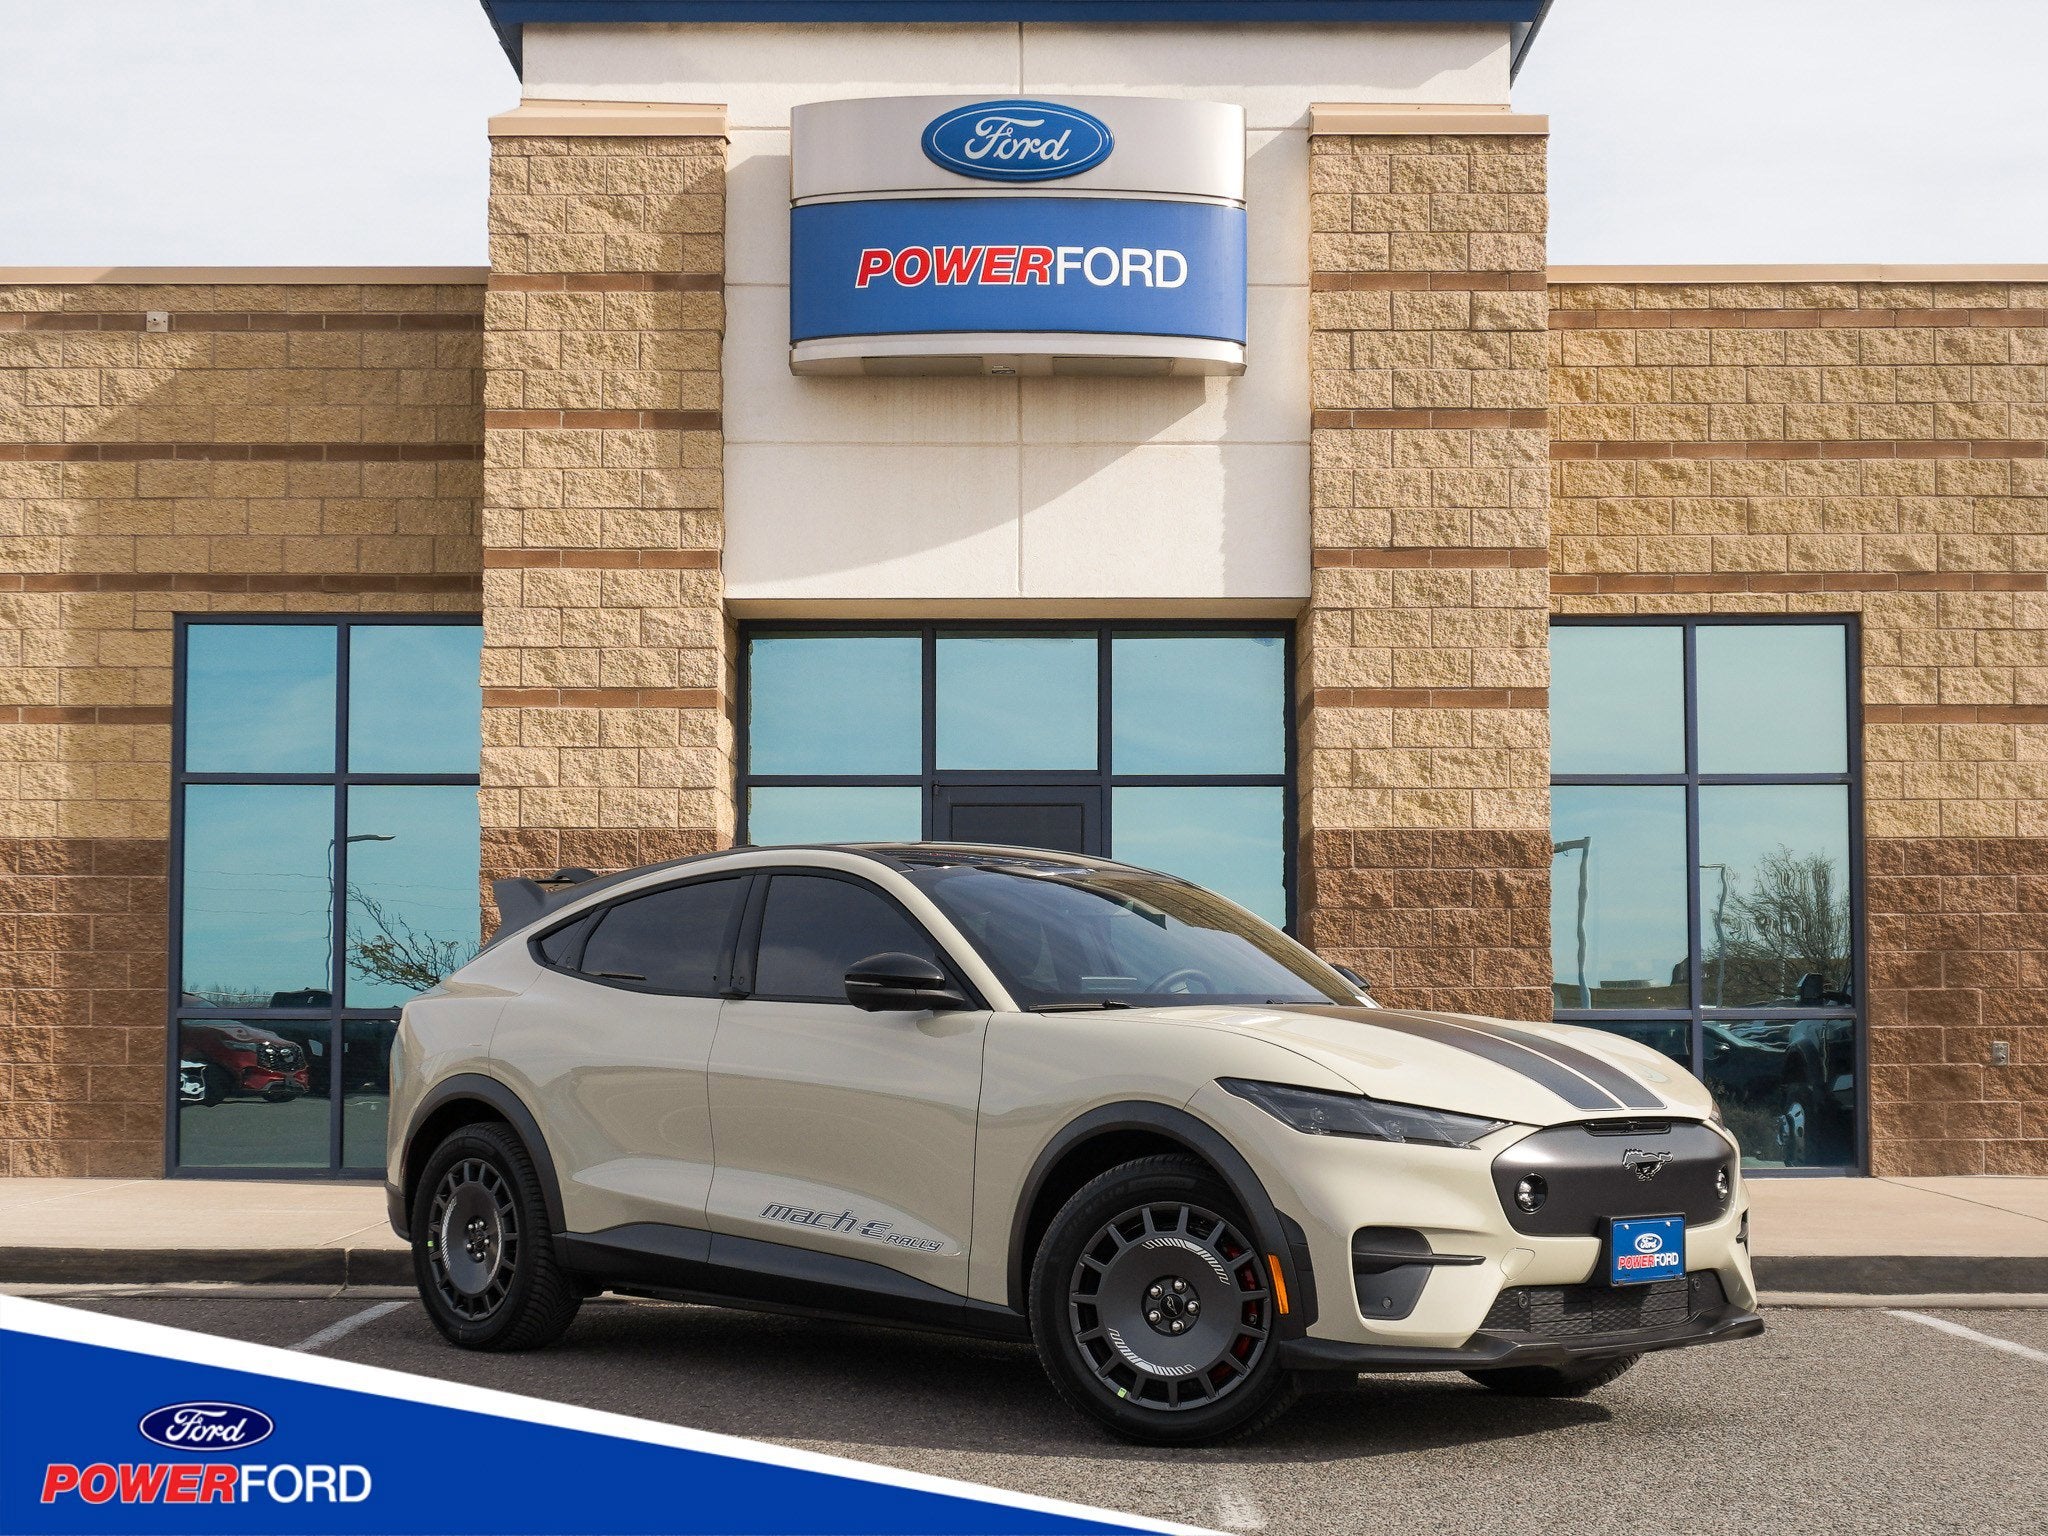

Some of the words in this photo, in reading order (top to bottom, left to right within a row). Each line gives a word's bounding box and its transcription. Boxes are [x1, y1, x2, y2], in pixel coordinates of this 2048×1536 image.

[964, 116, 1072, 162] Ford
[883, 1233, 944, 1252] RALLY
[1639, 1235, 1658, 1249] Ford
